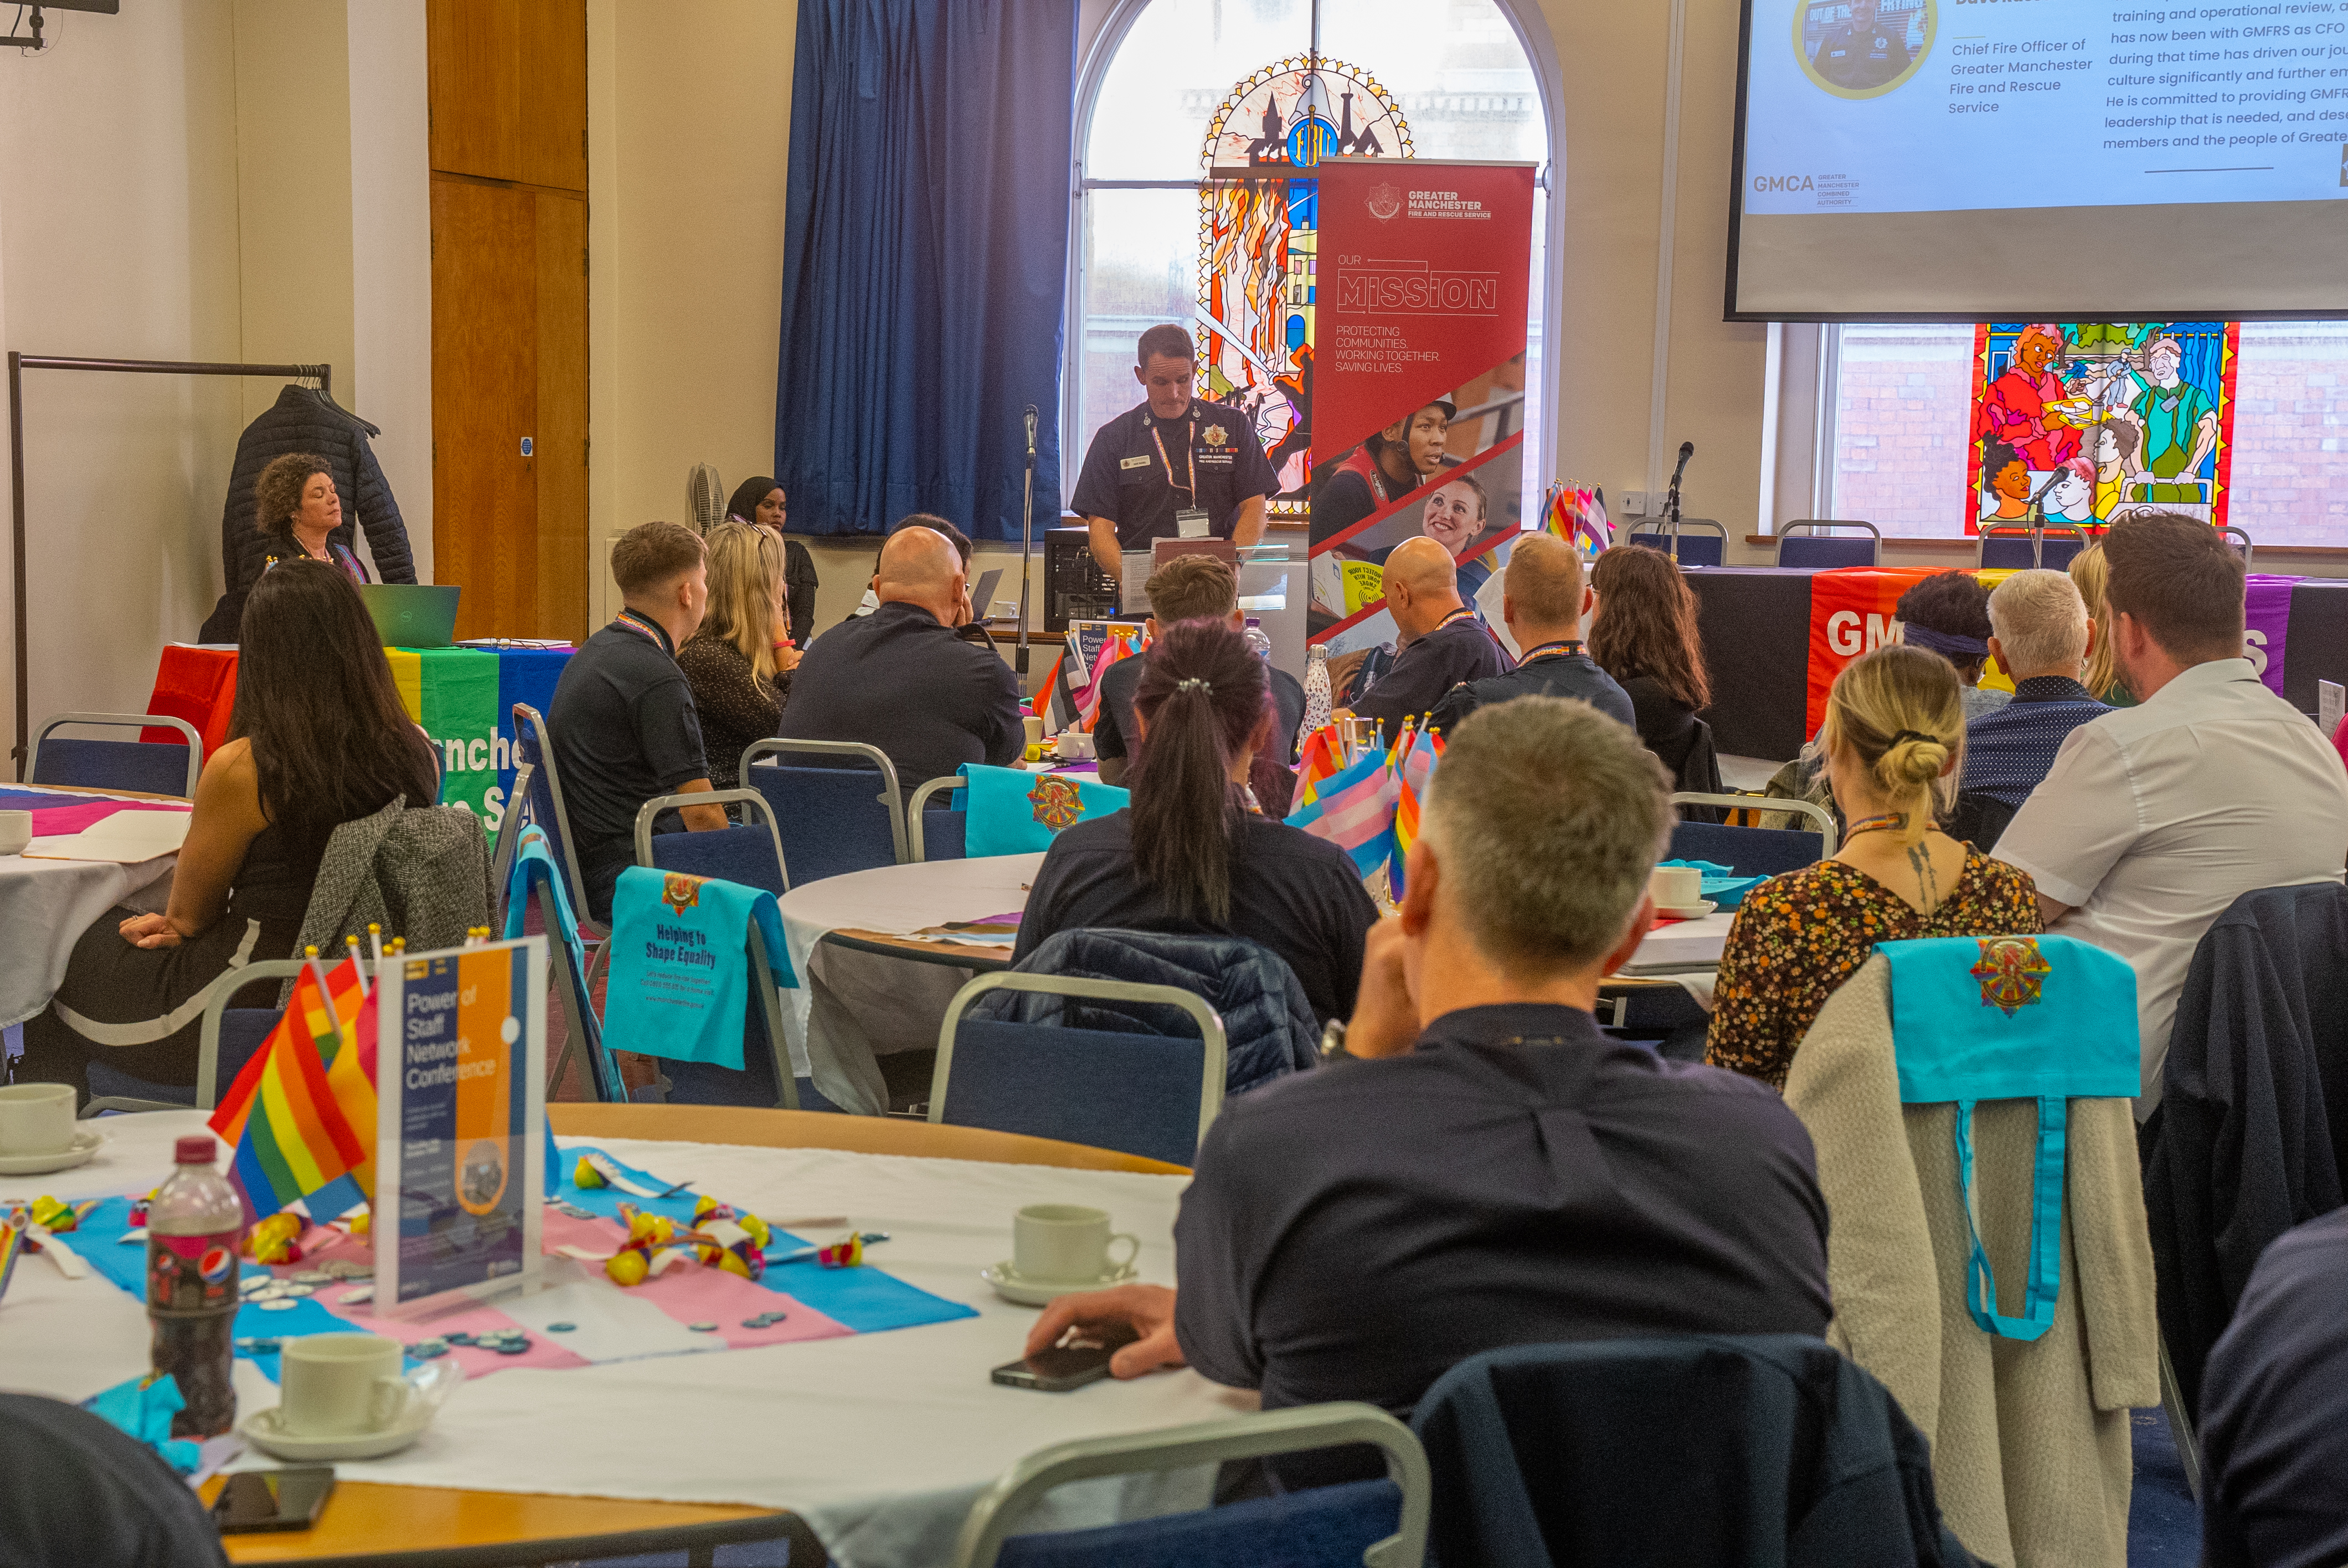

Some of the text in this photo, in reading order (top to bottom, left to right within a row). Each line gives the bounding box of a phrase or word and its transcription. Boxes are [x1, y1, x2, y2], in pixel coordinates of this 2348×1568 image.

[2113, 10, 2165, 24] training
[2169, 8, 2196, 19] and
[2200, 3, 2281, 21] operational
[2285, 2, 2335, 14] review,
[2111, 23, 2345, 43] has now been with GMFRS as CFO
[1953, 39, 2086, 55] Chief Fire Officer of
[2109, 54, 2153, 66] during
[2158, 51, 2185, 63] that
[2189, 50, 2220, 61] time
[2225, 49, 2249, 59] has
[2253, 47, 2297, 58] driven
[2301, 48, 2325, 56] our
[1951, 60, 2093, 75] Greater Manchester
[2108, 75, 2155, 86] culture
[2159, 70, 2242, 86] significantly
[2246, 69, 2273, 80] and
[2278, 68, 2326, 79] further
[1950, 81, 2061, 94] Fire and Rescue
[2107, 96, 2124, 107] He
[2128, 95, 2138, 106] is
[2141, 92, 2217, 105] committed
[2222, 92, 2235, 102] to
[2239, 90, 2306, 105] providing
[1949, 101, 1999, 113] Service
[2105, 115, 2176, 129] leadership
[2180, 114, 2208, 125] that
[2212, 113, 2222, 124] is
[2227, 111, 2283, 123] needed,
[2287, 110, 2315, 121] and
[2103, 137, 2169, 149] members
[2172, 135, 2199, 146] and
[2203, 135, 2225, 145] the
[2229, 133, 2278, 148] people
[2281, 132, 2295, 143] of
[1754, 175, 1814, 192] GMCA
[1408, 190, 1458, 200] GREATER
[1408, 200, 1481, 210] MANCHESTER
[1338, 255, 1361, 265] OUR
[1336, 326, 1400, 337] PROTECTING
[1336, 337, 1408, 349] COMMUNITIES.
[1335, 350, 1440, 361] WORKING TOGETHER.
[1335, 362, 1403, 373] SAVING LIVES.
[1083, 635, 1106, 643] Power
[657, 924, 706, 947] Helping to
[646, 942, 715, 970] Shape Equality
